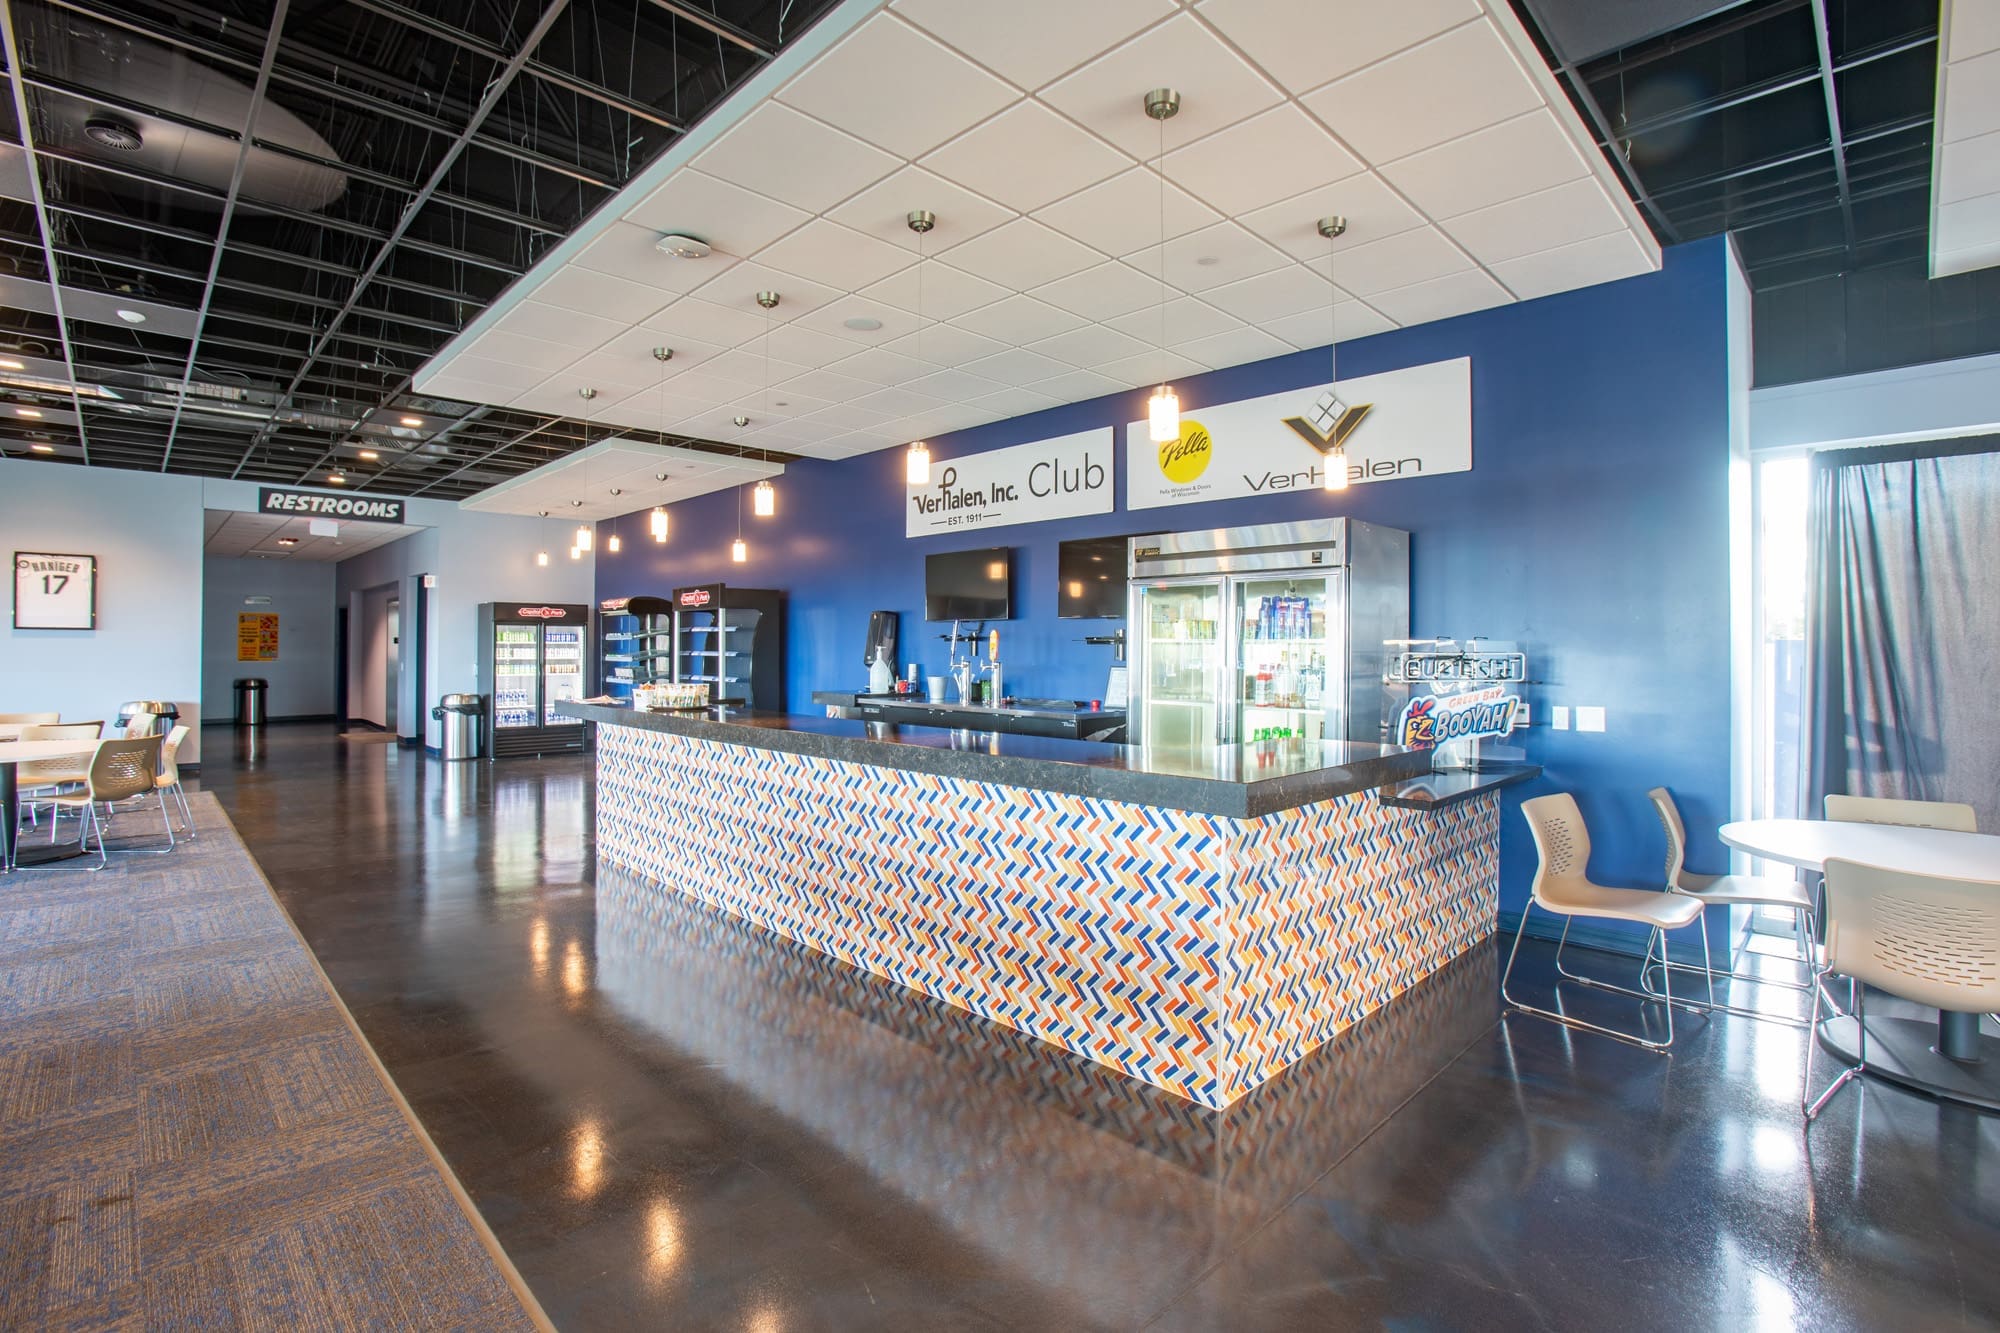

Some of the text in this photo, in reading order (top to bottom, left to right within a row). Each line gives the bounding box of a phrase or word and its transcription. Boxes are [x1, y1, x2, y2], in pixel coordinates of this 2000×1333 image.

[1161, 431, 1209, 469] Pella
[1028, 452, 1105, 498] Club
[991, 482, 1019, 504] Inc.
[266, 493, 399, 518] RESTROOMS
[947, 513, 983, 526] EST. 1911
[42, 574, 69, 595] 17
[1449, 687, 1503, 708] GREEN BAY
[1433, 700, 1515, 742] BOOYAH!
